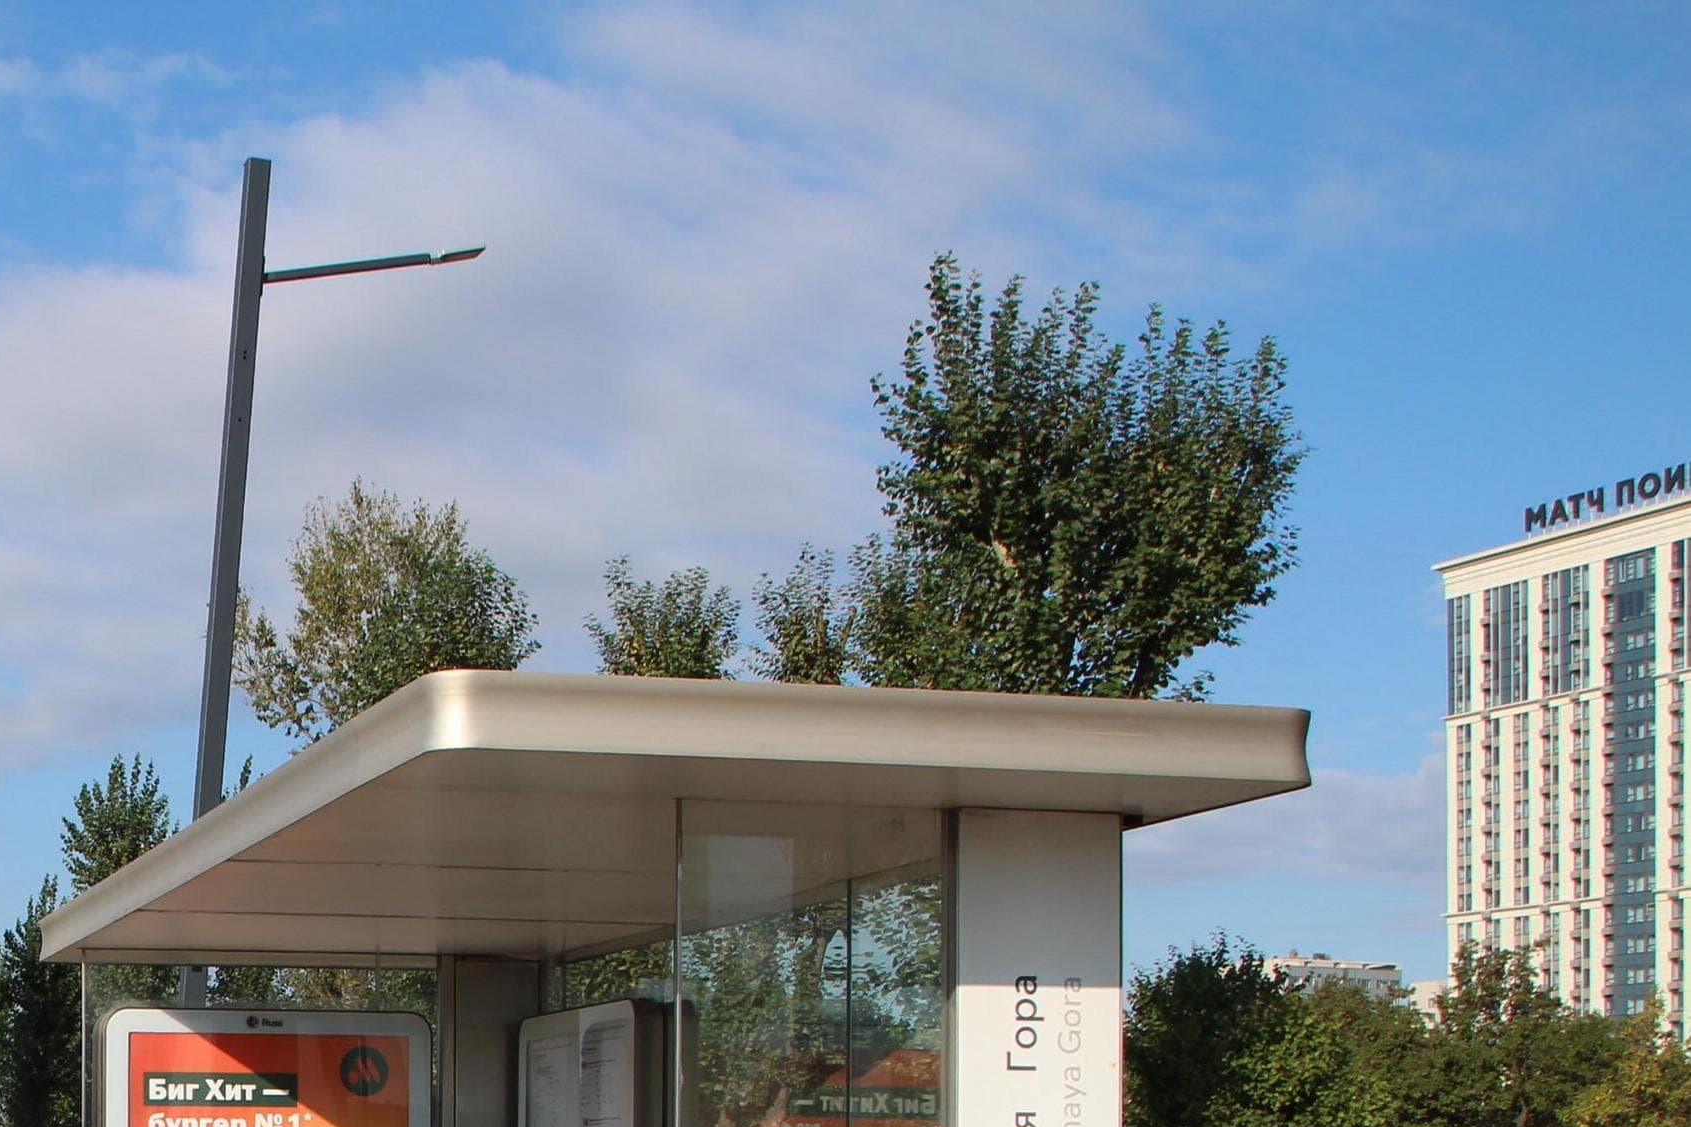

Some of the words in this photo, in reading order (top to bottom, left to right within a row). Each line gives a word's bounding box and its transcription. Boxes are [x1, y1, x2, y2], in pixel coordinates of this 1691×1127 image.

[1524, 487, 1604, 532] МАТЧ
[1616, 463, 1691, 507] ПОИ
[1005, 975, 1045, 1072] Гора
[1056, 976, 1084, 1056] Gora
[148, 1078, 199, 1101] Биг
[205, 1078, 256, 1101] Хит
